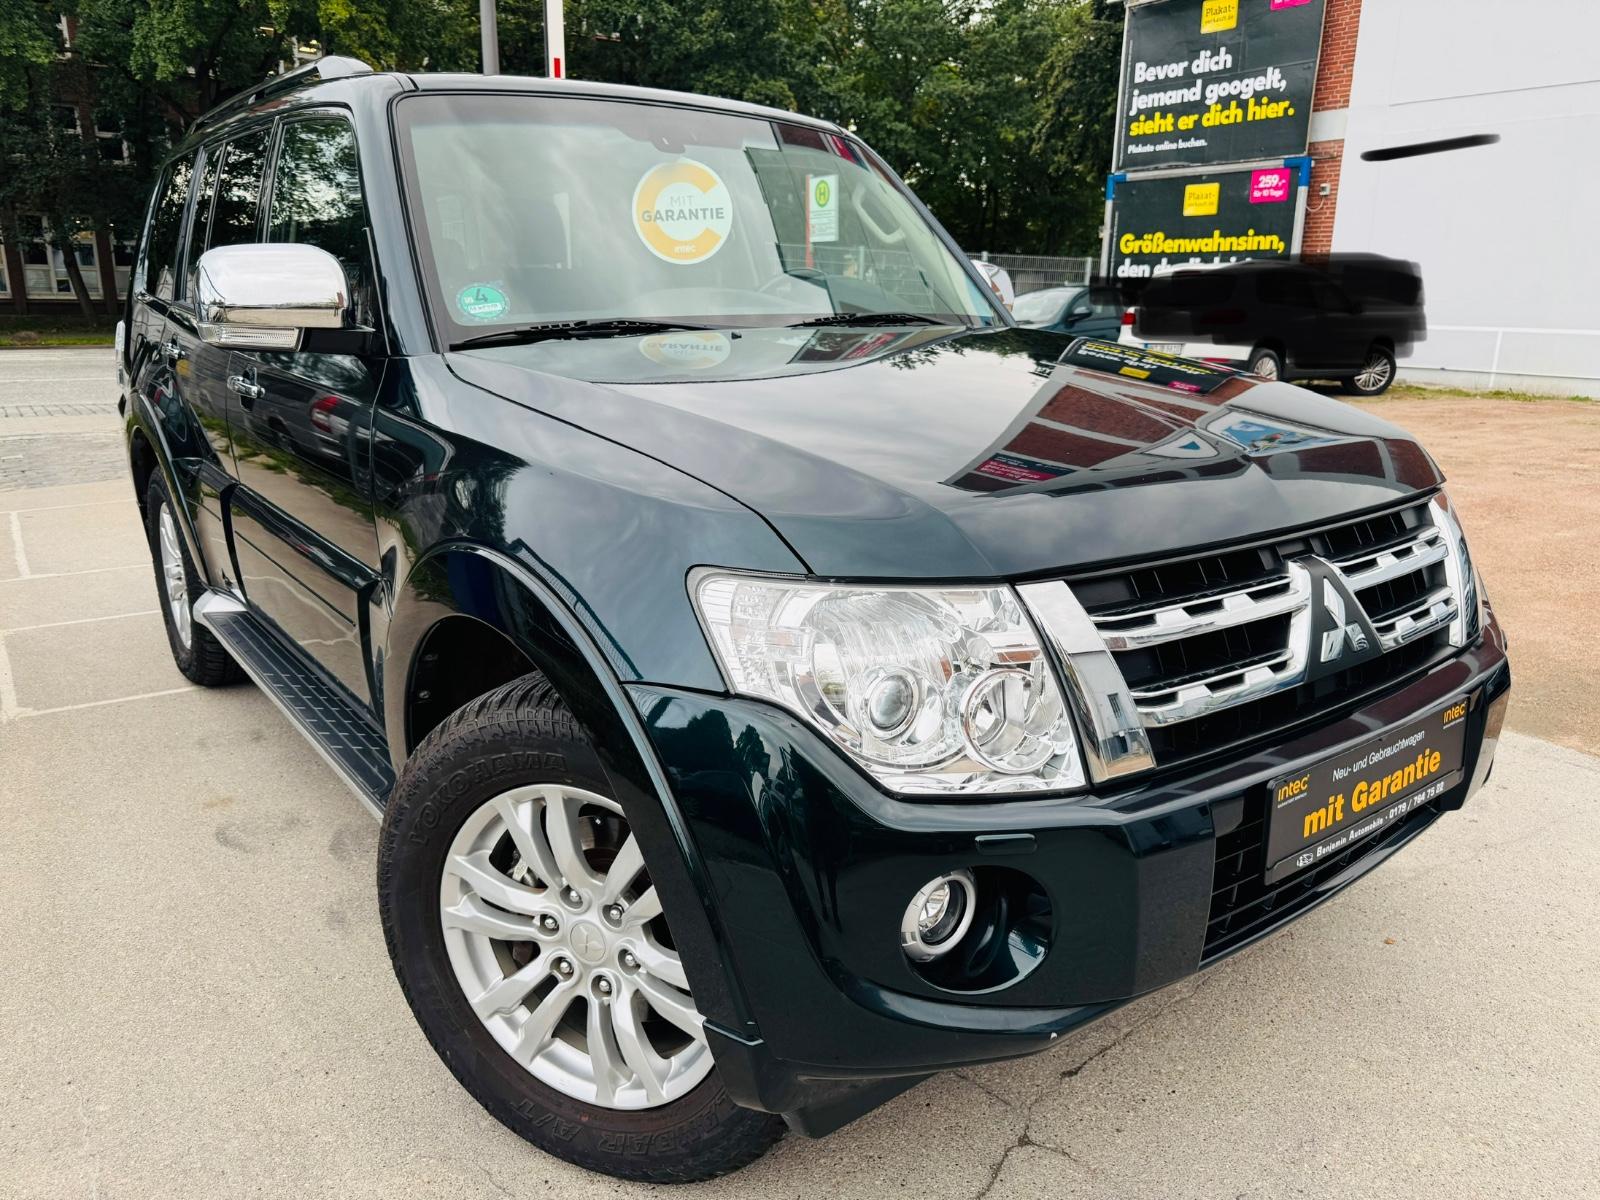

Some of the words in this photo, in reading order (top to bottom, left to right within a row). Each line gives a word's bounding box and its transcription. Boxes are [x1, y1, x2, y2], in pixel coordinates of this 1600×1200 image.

[1134, 60, 1188, 84] Bevor
[1191, 47, 1232, 75] dich
[1129, 79, 1202, 116] jemand
[1205, 66, 1287, 105] googelt,
[1129, 112, 1174, 137] sieht
[1178, 113, 1199, 131] er
[1201, 100, 1242, 128] dich
[1247, 96, 1295, 122] hier.
[1155, 140, 1177, 151] online
[642, 208, 725, 222] GARANTIE
[670, 195, 695, 207] MIT
[1120, 229, 1285, 254] Größenwahnsinn,
[1117, 257, 1150, 278] den
[1333, 766, 1352, 782] Neu-
[1353, 755, 1367, 773] und
[1369, 730, 1425, 766] Gebrauchtwagen
[1303, 792, 1345, 838] mit
[1351, 748, 1441, 812] Garantie
[1316, 837, 1347, 857] Benjamin
[1349, 817, 1384, 841] Automobile
